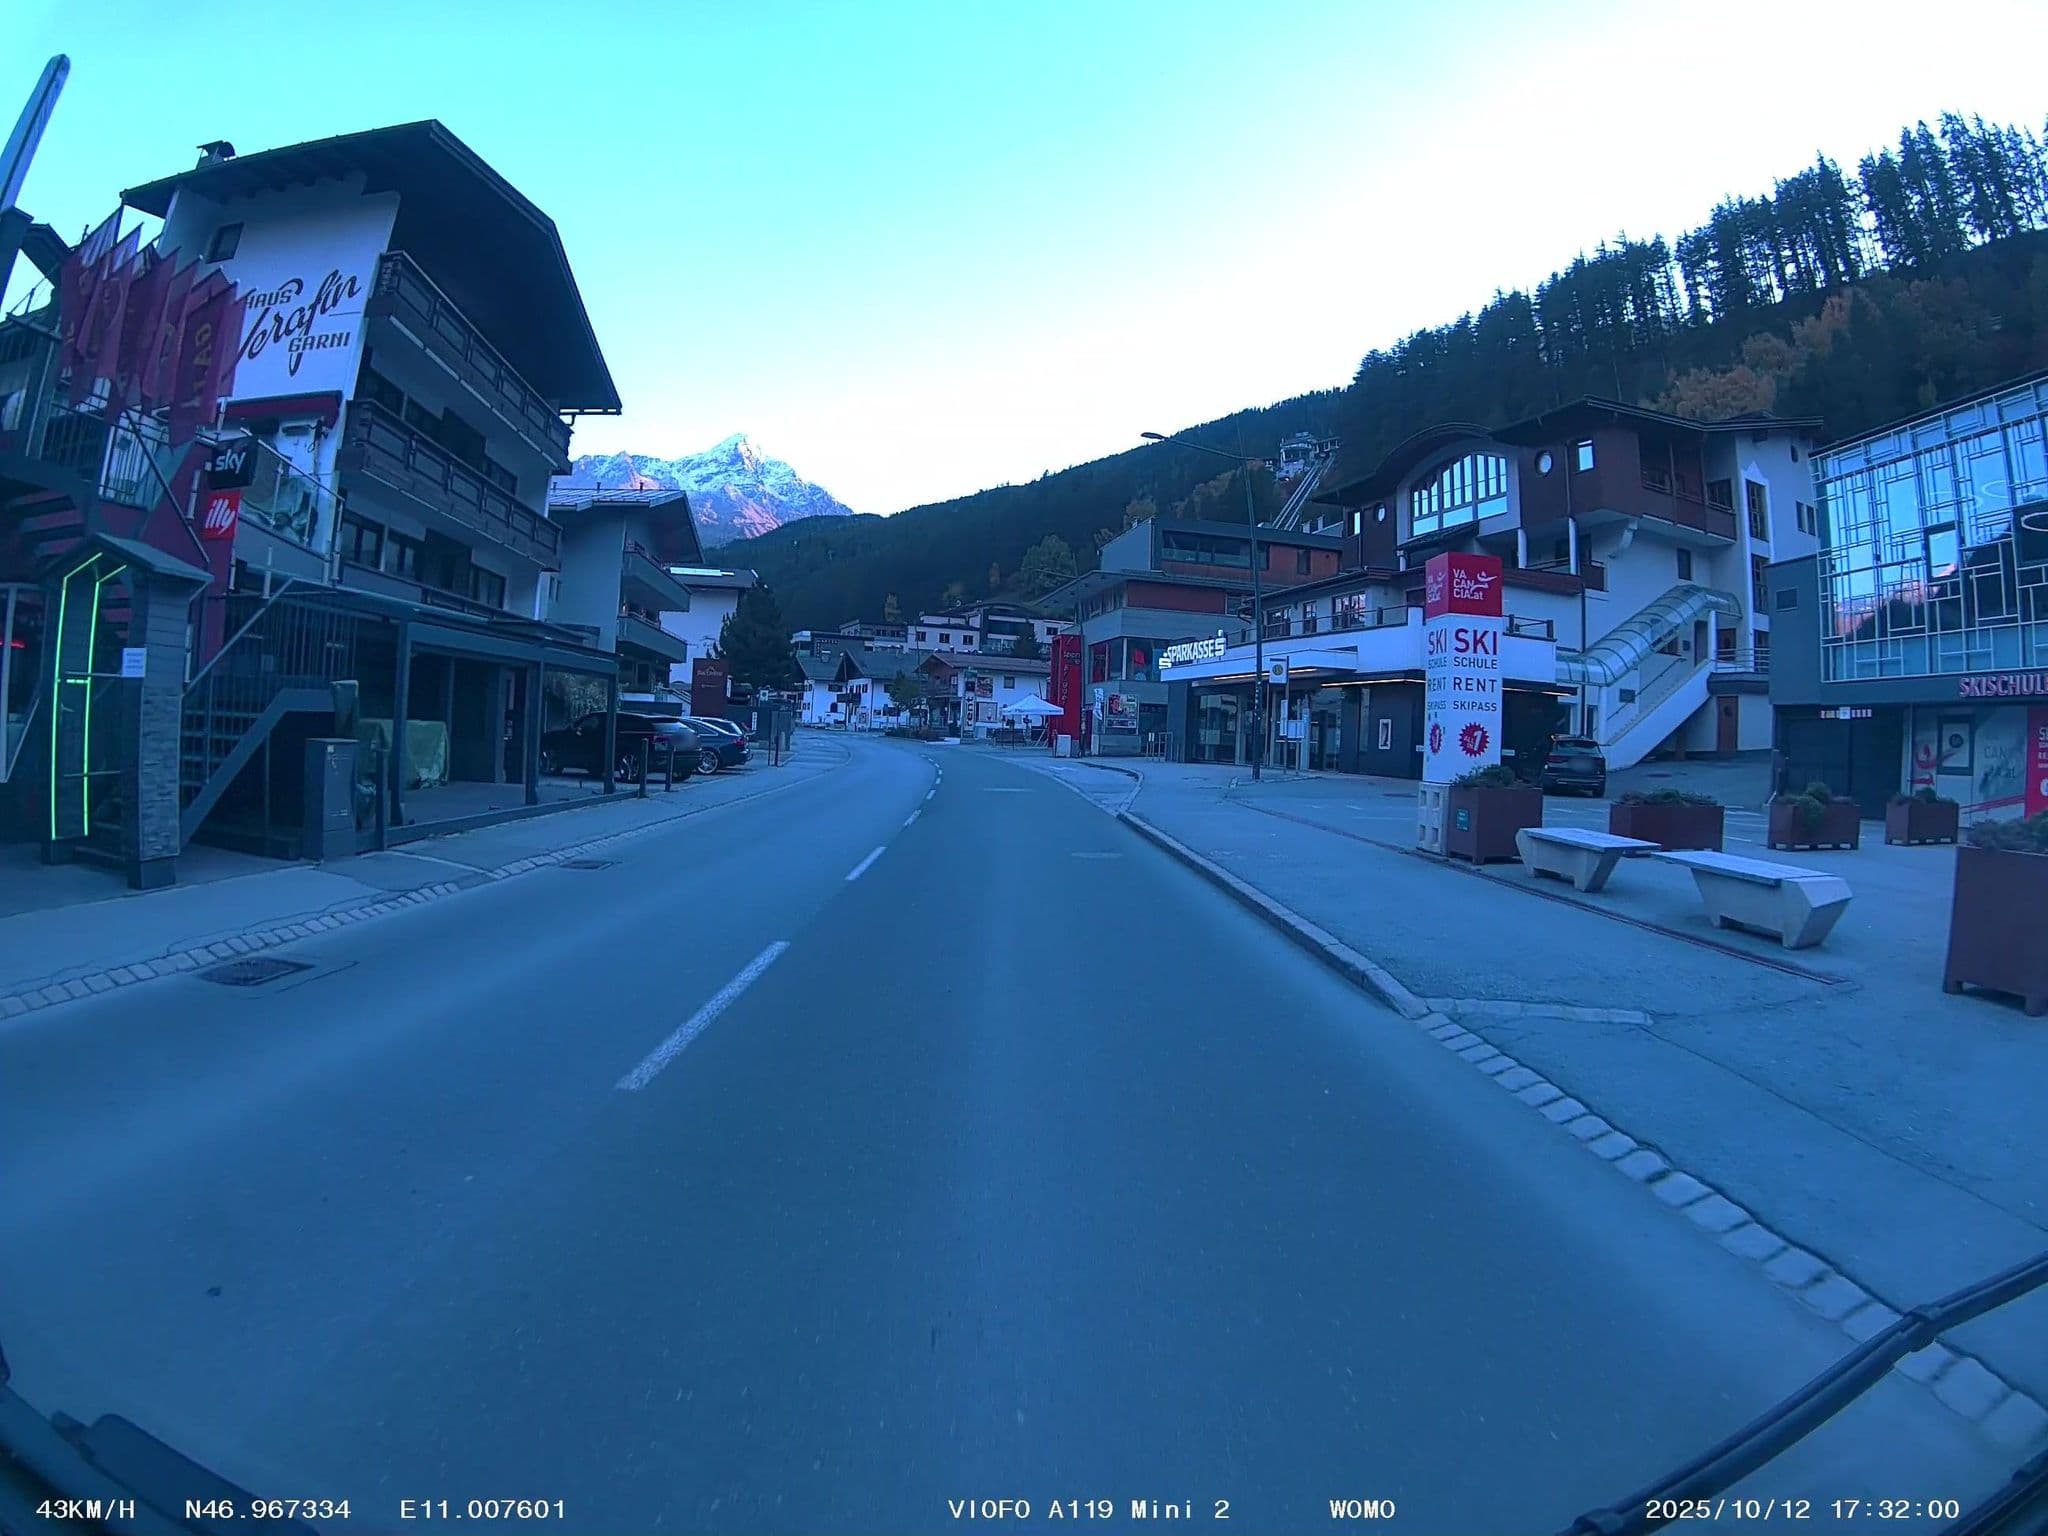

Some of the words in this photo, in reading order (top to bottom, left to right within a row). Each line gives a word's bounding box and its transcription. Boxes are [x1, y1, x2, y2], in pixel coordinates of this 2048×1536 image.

[288, 331, 351, 353] GARNI
[215, 448, 247, 474] sky
[205, 498, 236, 535] illy
[1452, 568, 1467, 579] VA
[1453, 578, 1475, 589] CAN
[1167, 639, 1214, 663] SPARKASSE
[1428, 628, 1447, 655] SKI
[1454, 628, 1498, 656] SKI
[1453, 656, 1498, 669] SCHULE
[1453, 676, 1497, 693] RENT
[1453, 700, 1497, 712] SKIPASS
